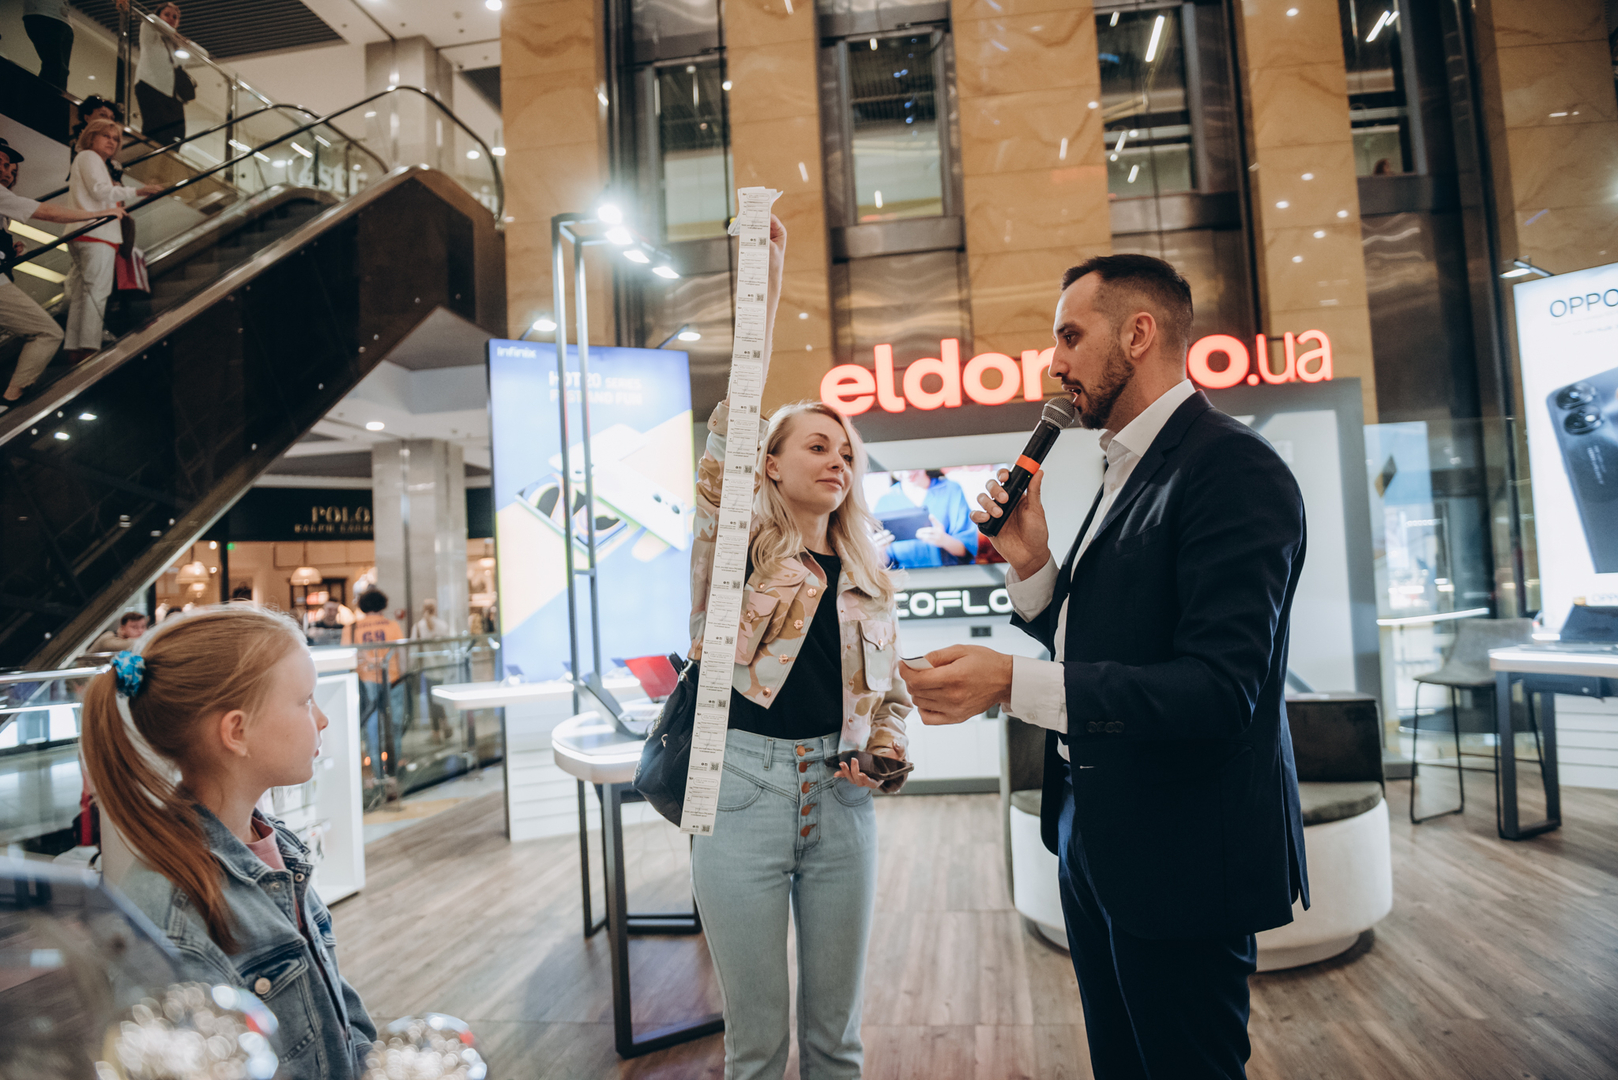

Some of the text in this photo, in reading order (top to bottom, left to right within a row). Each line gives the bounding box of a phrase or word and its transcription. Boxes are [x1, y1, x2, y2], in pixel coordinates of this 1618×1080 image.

[1549, 288, 1618, 318] OPPO
[819, 328, 1334, 417] eldoro.ua
[312, 505, 371, 523] POLO
[894, 588, 1013, 618] COFLO
